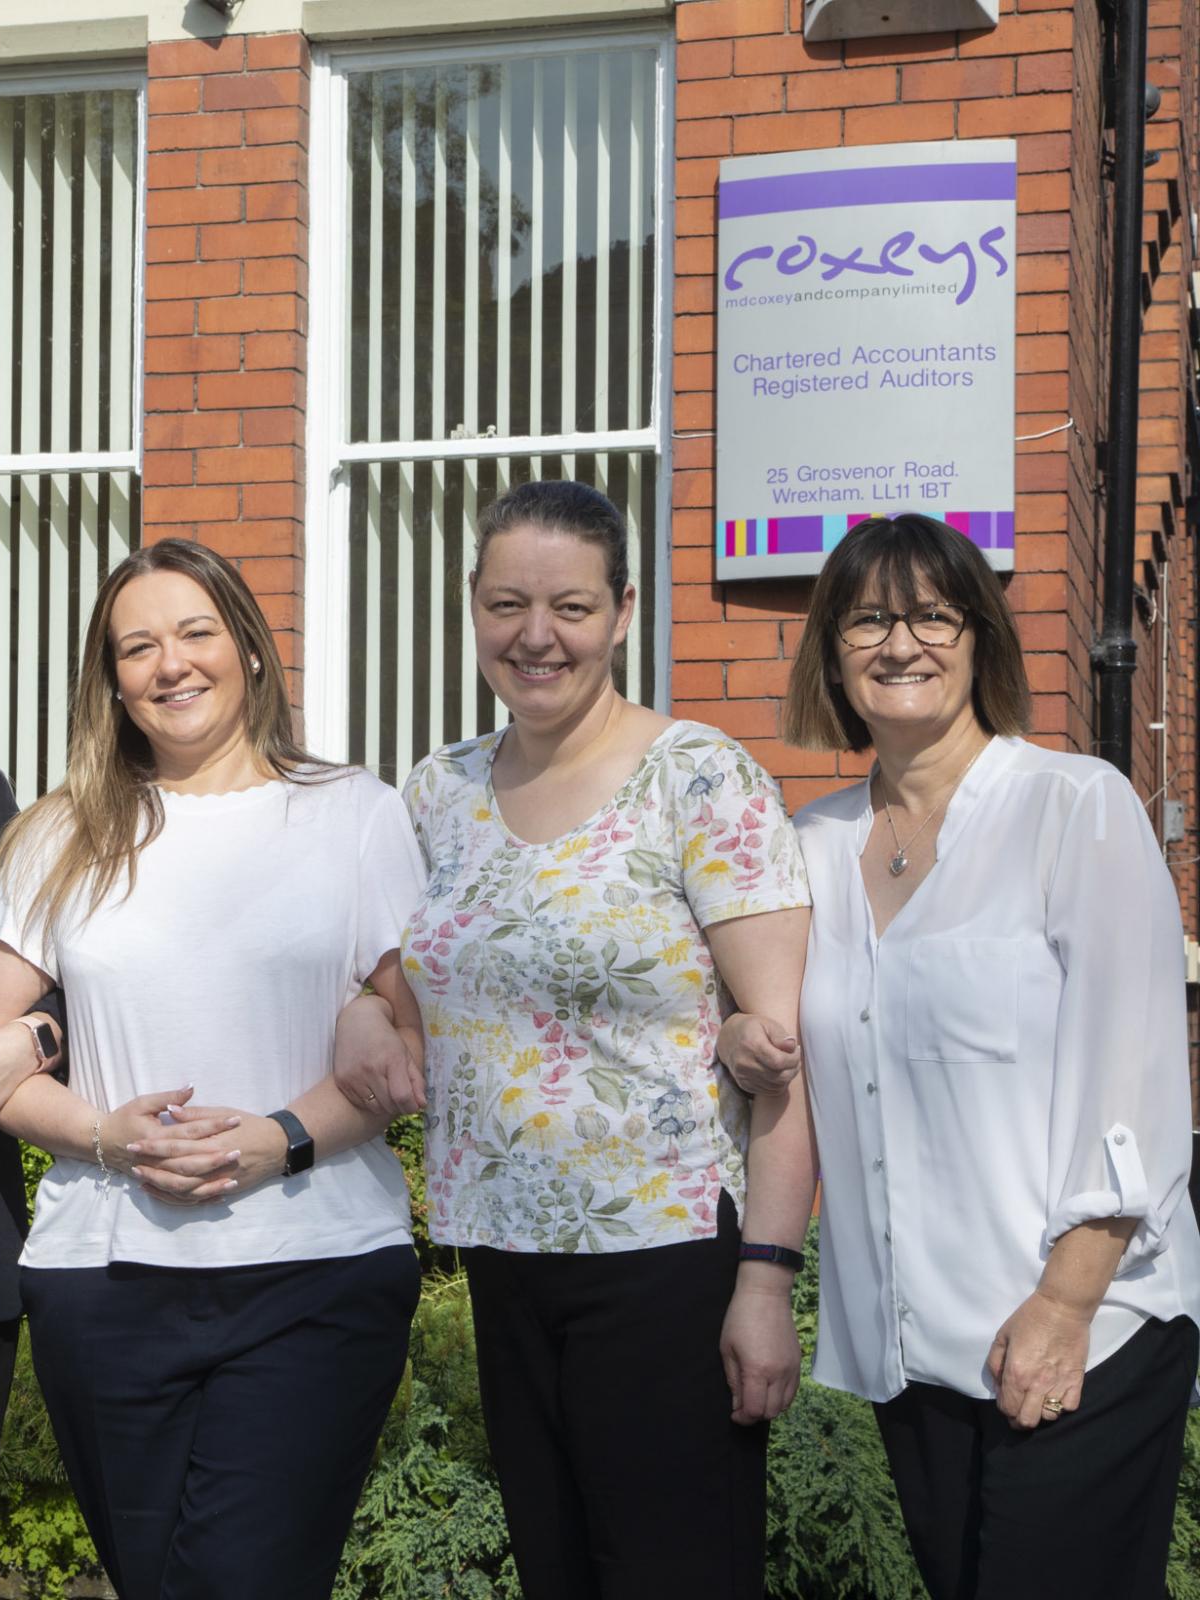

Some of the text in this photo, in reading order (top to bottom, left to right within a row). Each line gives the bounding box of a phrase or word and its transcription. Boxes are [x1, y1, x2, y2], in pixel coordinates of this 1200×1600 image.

[733, 343, 997, 374] Chartered Accountants
[753, 368, 974, 399] Registered Auditors
[766, 467, 789, 485] 25
[796, 465, 895, 482] Grosvenor
[872, 483, 910, 500] LL11
[919, 481, 952, 499] 1BT
